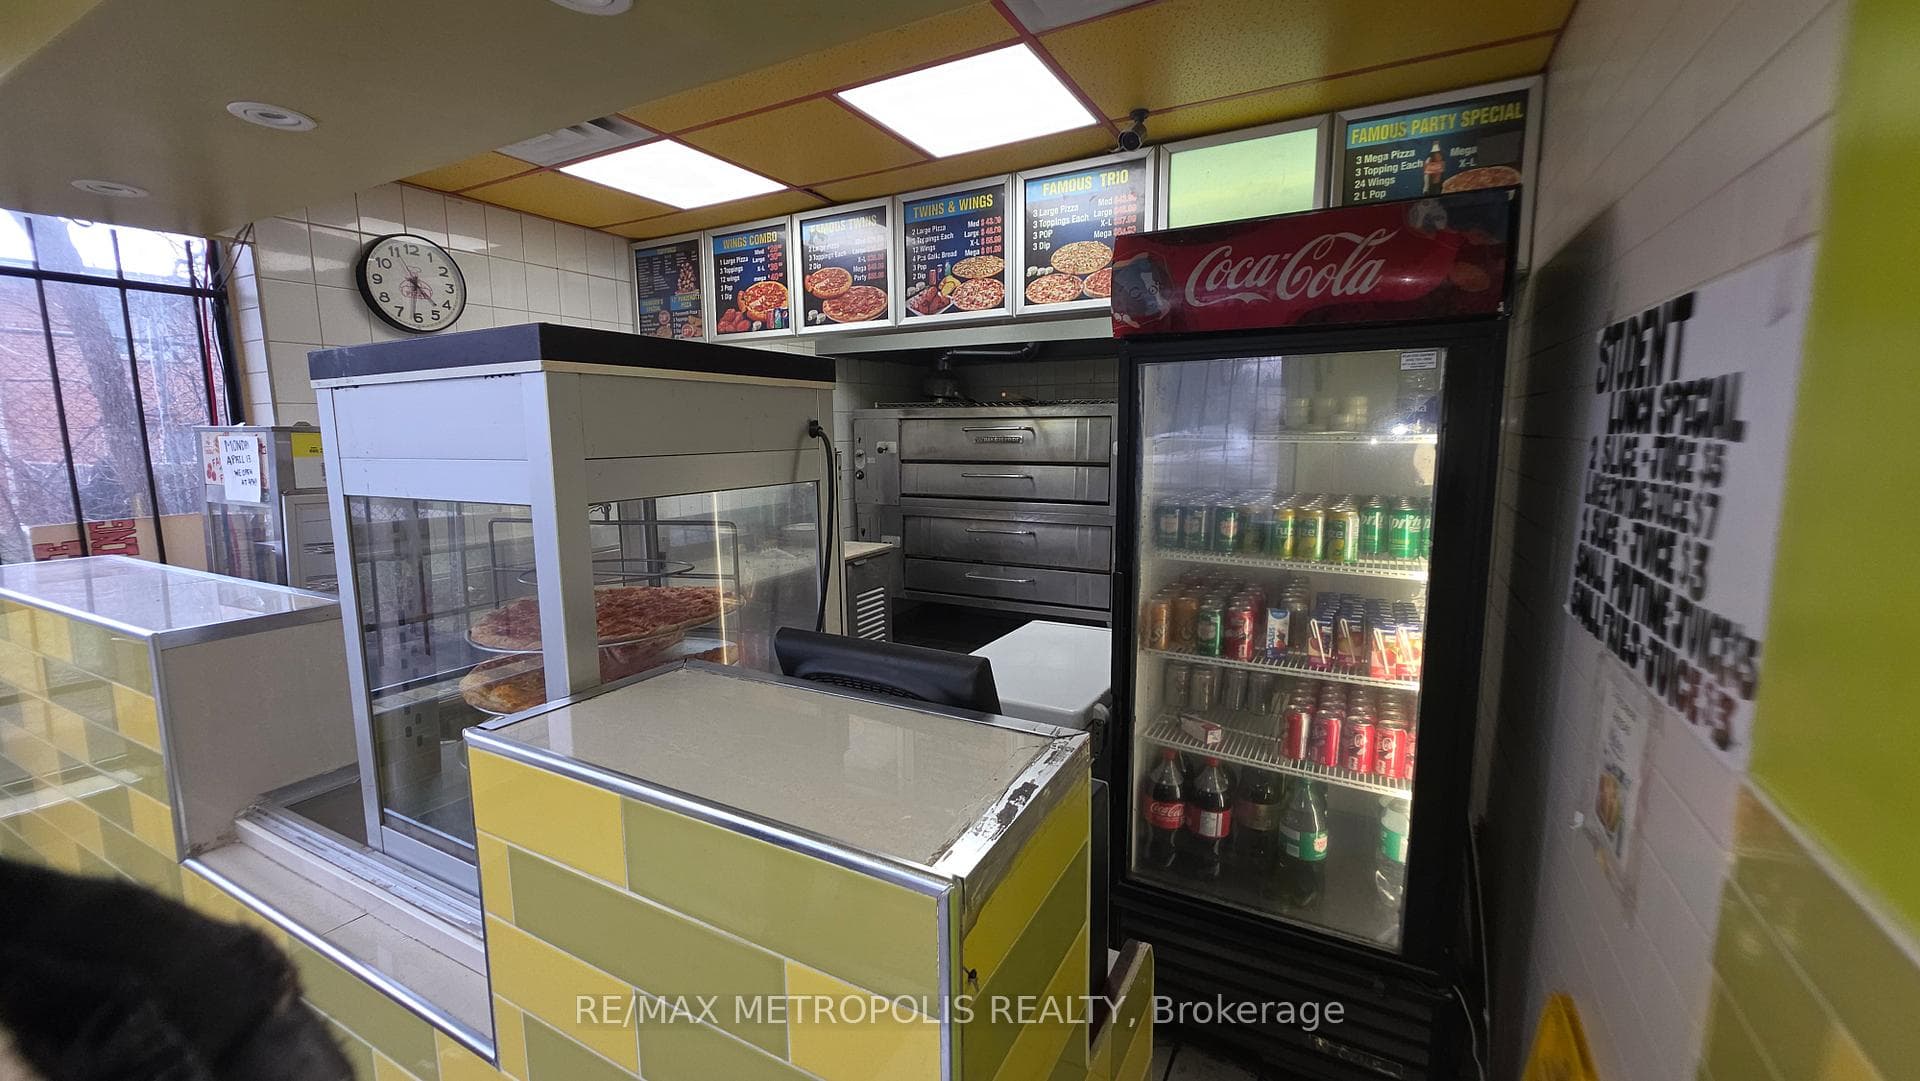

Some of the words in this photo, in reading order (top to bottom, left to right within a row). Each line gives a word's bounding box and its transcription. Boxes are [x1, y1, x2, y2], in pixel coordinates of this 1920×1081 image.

[1351, 122, 1407, 145] FAMOUS
[1411, 113, 1457, 136] PARTY
[1460, 102, 1523, 128] SPECIAL
[1356, 156, 1362, 164] 3
[1364, 152, 1389, 165] Mega
[1391, 149, 1416, 159] Pizza
[1450, 146, 1478, 157] Mega
[1355, 168, 1362, 177] 3
[1363, 163, 1399, 177] Topping
[1401, 160, 1424, 171] Each
[1458, 158, 1477, 168] X-L
[1042, 175, 1092, 196] FAMOUS
[1100, 169, 1129, 187] TRIO
[1355, 180, 1366, 189] 24
[1368, 176, 1396, 189] Wings
[1354, 192, 1360, 201] 2
[1362, 191, 1367, 199] L
[1369, 188, 1387, 200] Pop
[913, 203, 945, 219] TWINS
[948, 201, 955, 213] &
[959, 193, 993, 211] WINGS
[1098, 197, 1112, 206] Med
[1033, 209, 1038, 217] 3
[1039, 207, 1059, 218] Large
[1060, 204, 1079, 214] Pizza
[1093, 208, 1112, 219] Large
[968, 220, 980, 228] Med
[1033, 220, 1038, 229] 3
[1039, 217, 1070, 229] Toppings
[1072, 214, 1089, 224] Each
[1100, 219, 1112, 228] X-L
[911, 228, 916, 236] 2
[940, 232, 954, 241] Each
[964, 229, 980, 238] Large
[1033, 231, 1038, 239] 3
[1093, 230, 1112, 240] Mega
[723, 236, 747, 249] WINGS
[749, 231, 778, 246] COMBO
[969, 239, 980, 247] X-L
[388, 245, 401, 258] 11
[403, 243, 419, 256] 12
[1033, 243, 1038, 251] 3
[1039, 242, 1051, 251] Dip
[427, 251, 433, 263] 1
[941, 249, 958, 259] Bread
[964, 248, 980, 258] Mega
[375, 256, 392, 269] 10
[912, 264, 917, 272] 3
[1184, 228, 1399, 307] Coca-Cola
[438, 266, 449, 277] 2
[912, 273, 917, 281] 2
[917, 272, 926, 281] Dip
[371, 273, 383, 284] 9
[445, 283, 455, 294] 3
[379, 291, 391, 303] 8
[442, 300, 452, 310] 4
[394, 305, 405, 317] 7
[431, 310, 441, 321] 5
[413, 312, 424, 323] 6
[1596, 291, 1697, 394] STUDENT
